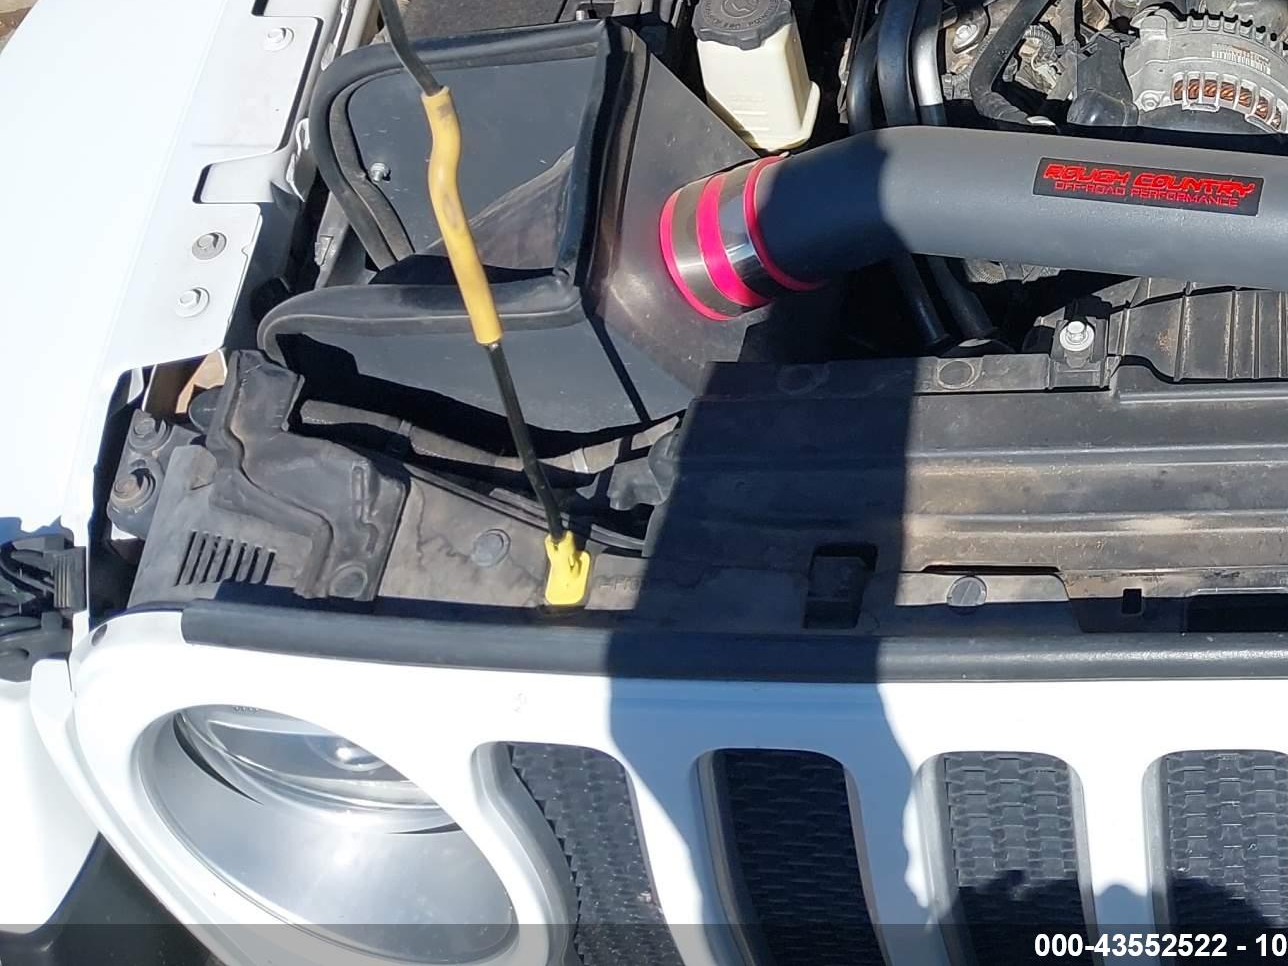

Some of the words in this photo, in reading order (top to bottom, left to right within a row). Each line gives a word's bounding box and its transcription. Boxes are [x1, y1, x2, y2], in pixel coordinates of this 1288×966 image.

[1043, 164, 1131, 186] ROUGH
[1133, 173, 1255, 198] COUNTRY
[1055, 181, 1126, 196] OFF-ROAD
[1130, 187, 1239, 208] PERFORMANCE
